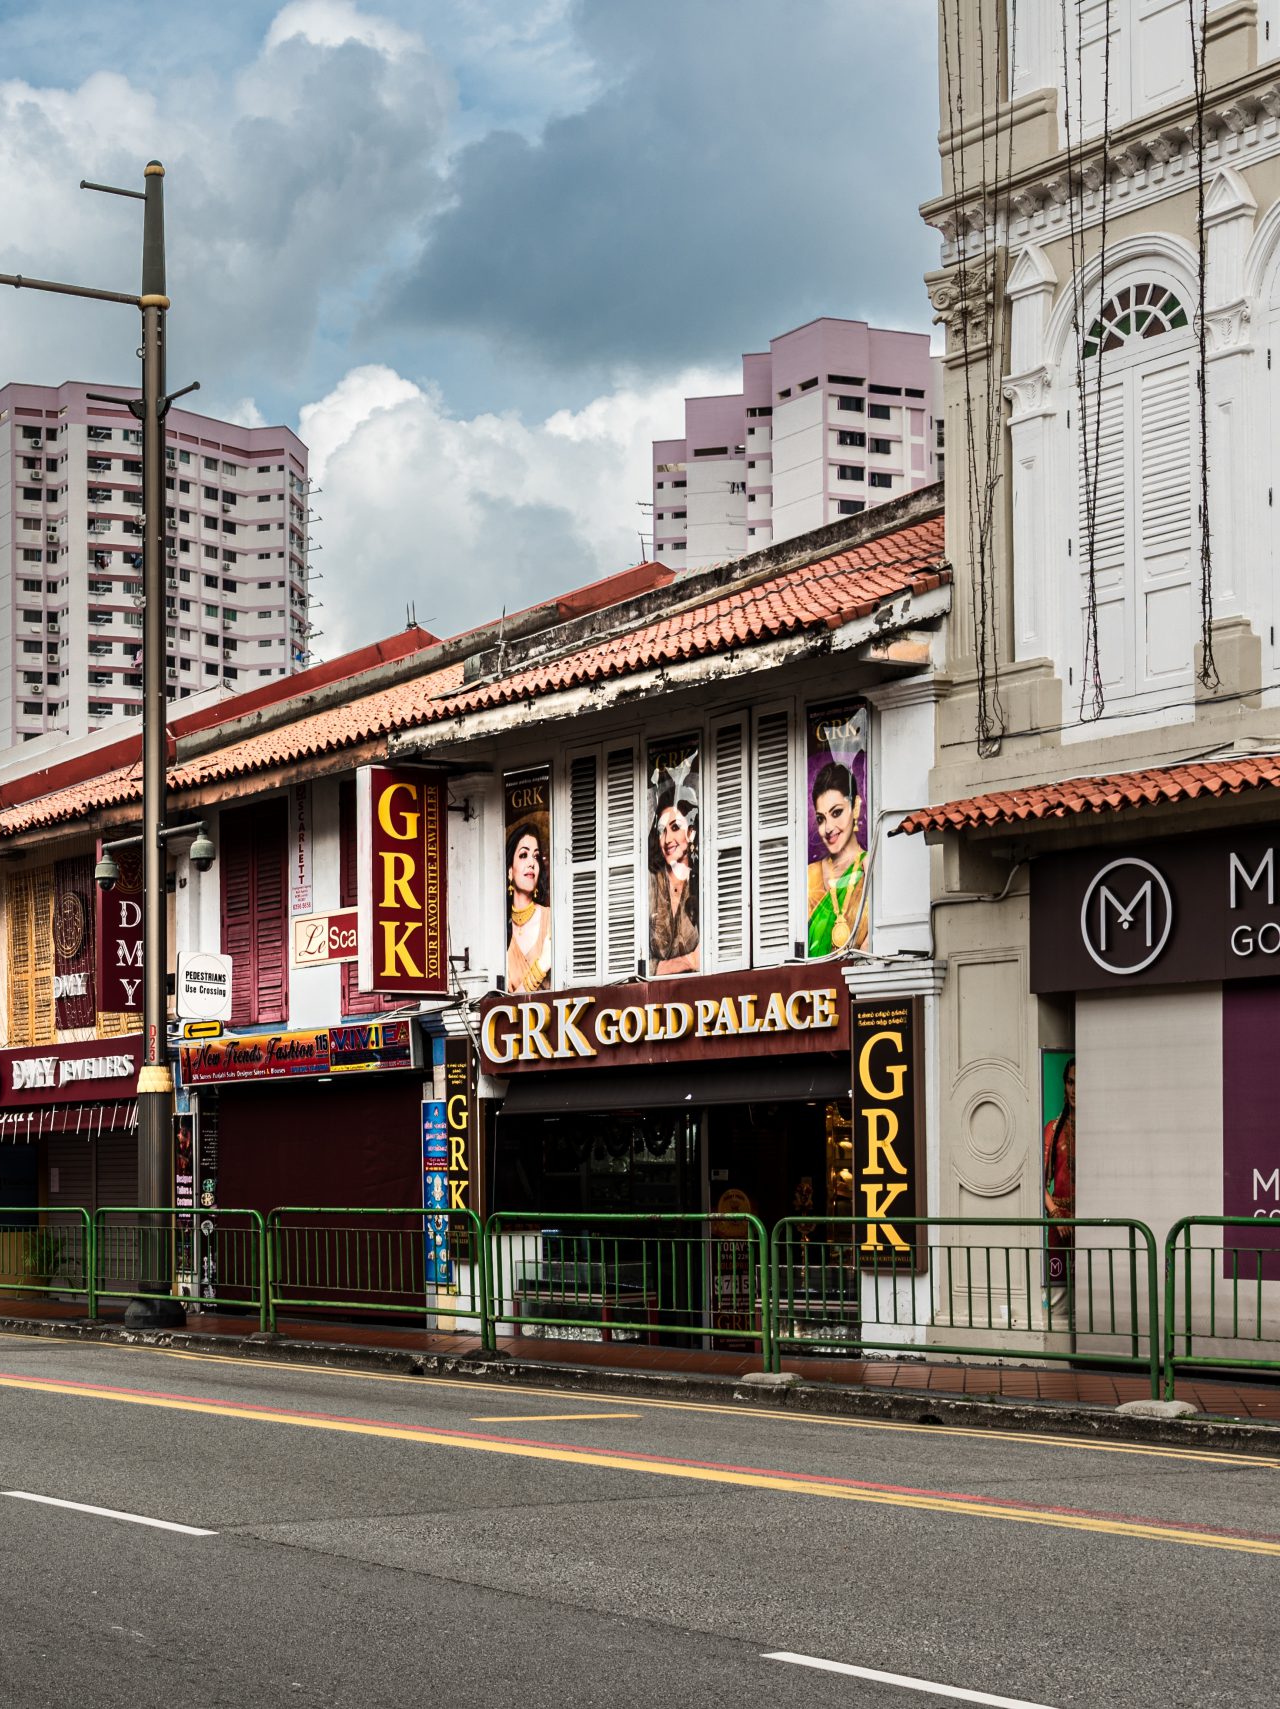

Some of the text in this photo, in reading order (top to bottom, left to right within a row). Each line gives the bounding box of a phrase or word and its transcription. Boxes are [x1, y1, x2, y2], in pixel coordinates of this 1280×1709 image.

[816, 717, 857, 741] GRK
[511, 786, 544, 808] GRK
[297, 801, 305, 885] SCARLETT
[378, 783, 424, 978] GRK
[427, 785, 438, 978] YOUR FAVOURITE JEWELLER
[116, 901, 144, 1006] DMY
[298, 923, 326, 957] Le
[54, 973, 89, 999] DMY
[185, 971, 226, 983] PEDESTRIANS
[185, 984, 226, 998] Use Crossing
[148, 1024, 158, 1062] D23
[482, 988, 840, 1065] GRK GOLD PALACE
[192, 1034, 328, 1069] New Trends Fashion 115
[12, 1055, 134, 1089] DMY JEWELLERS
[236, 1070, 253, 1078] Designer
[447, 1095, 469, 1209] GRK
[859, 1031, 910, 1252] GRK
[176, 1175, 192, 1184] Designer
[177, 1186, 188, 1195] Tailors
